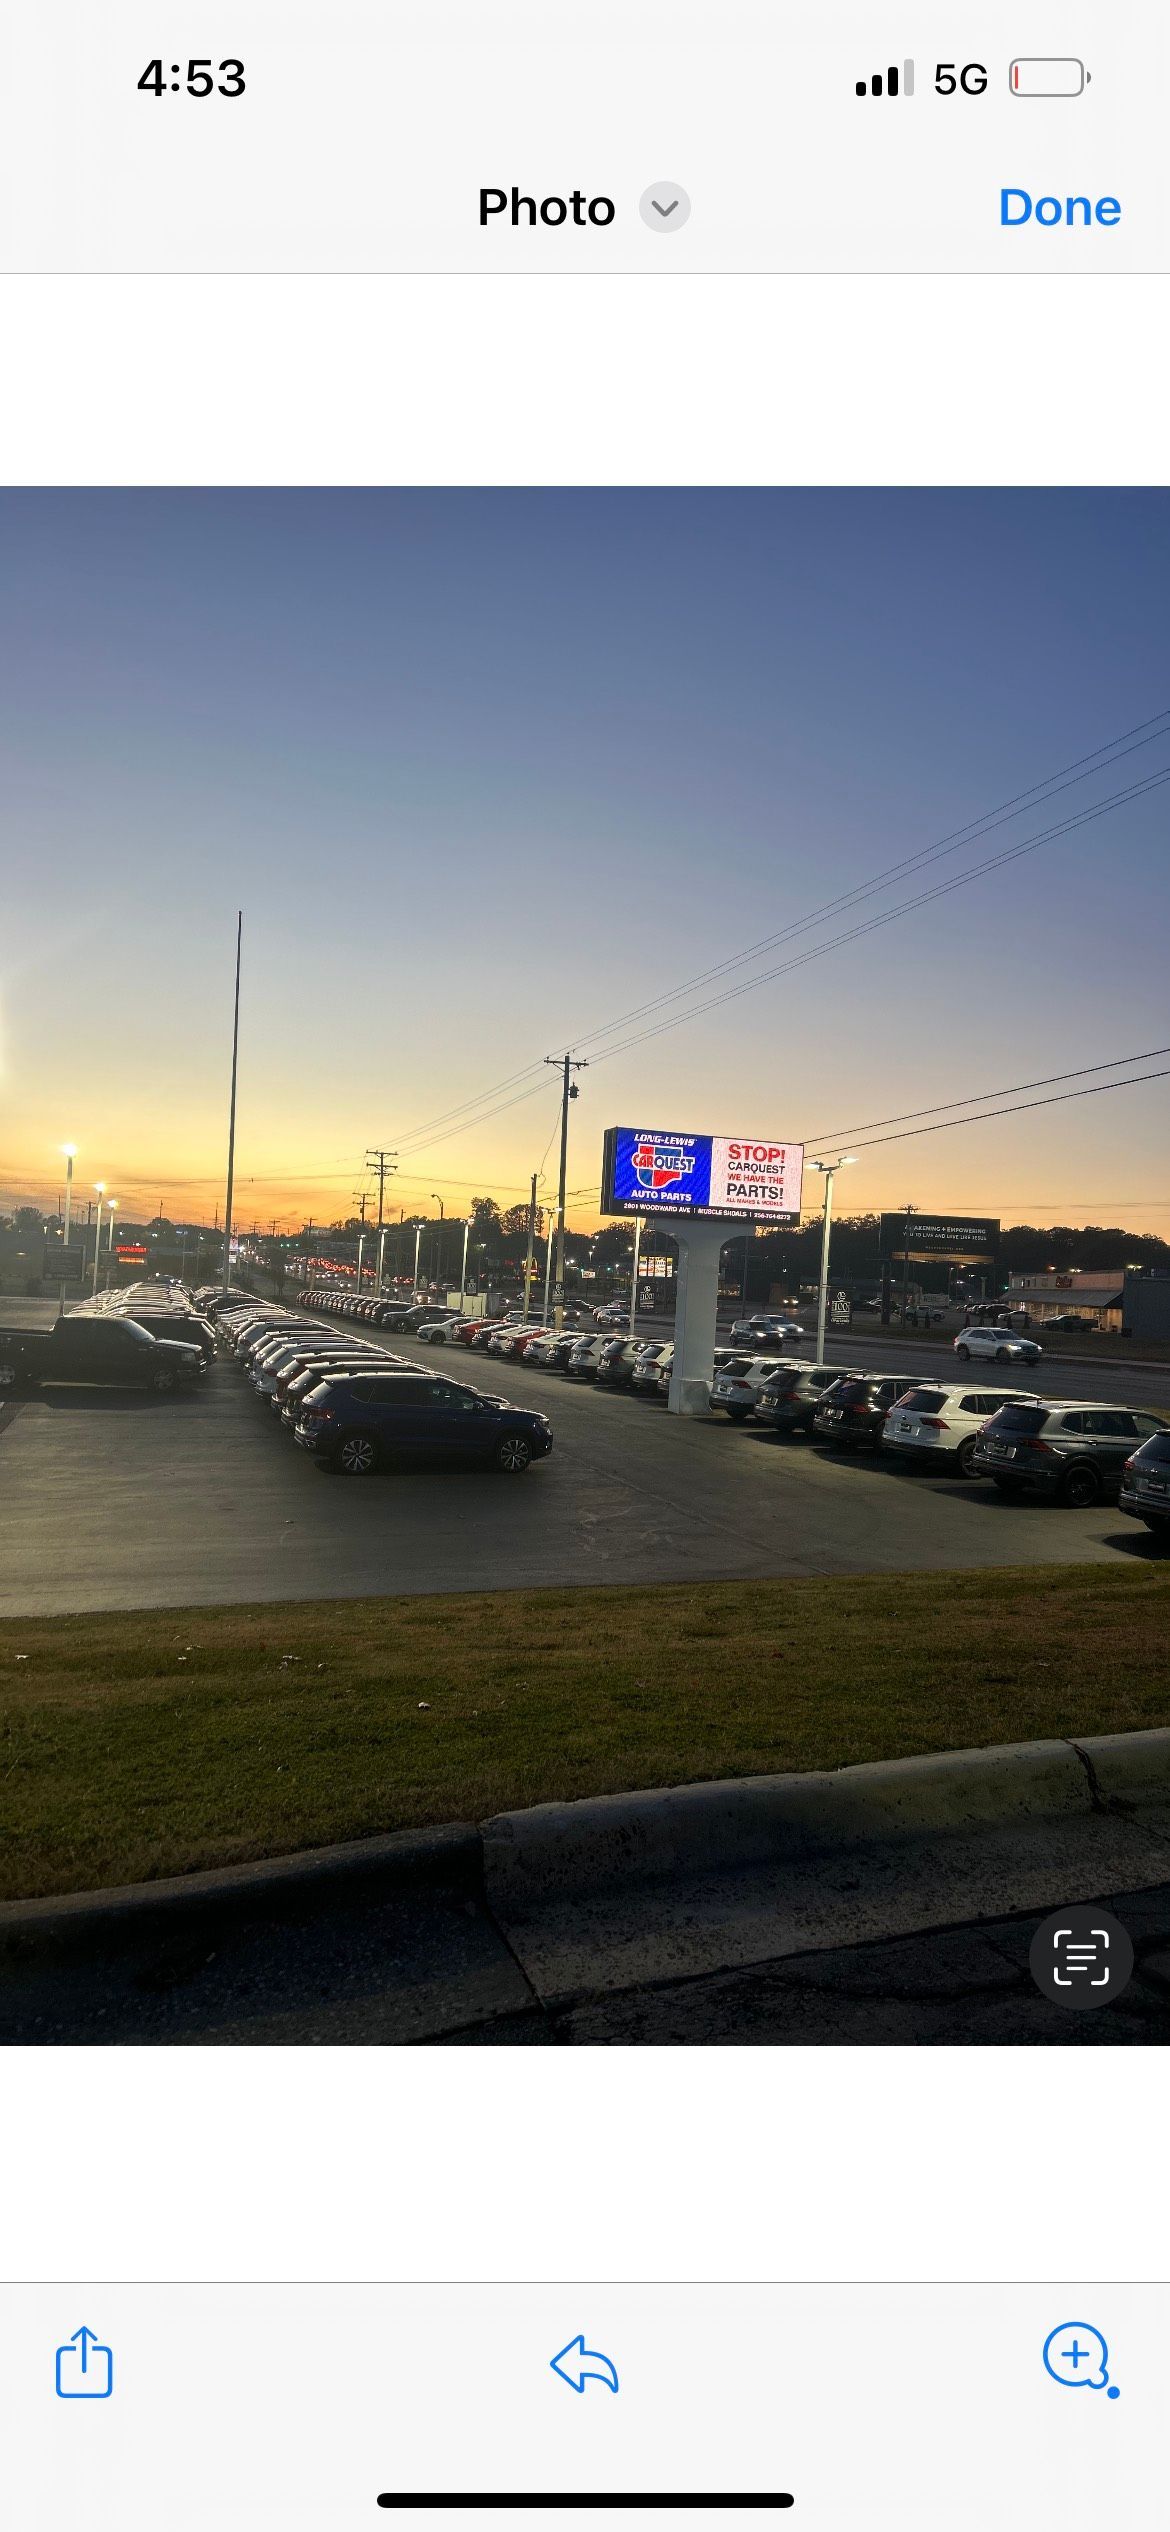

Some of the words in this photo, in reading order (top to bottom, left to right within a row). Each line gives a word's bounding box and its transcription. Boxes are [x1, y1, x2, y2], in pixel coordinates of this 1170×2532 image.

[634, 1134, 695, 1146] LONG-LEWIS
[728, 1144, 785, 1163] STOP!
[633, 1154, 694, 1171] CARQUEST
[728, 1162, 785, 1174] CARQUEST
[728, 1173, 741, 1181] WE
[744, 1174, 766, 1183] HAVE
[768, 1176, 784, 1185] THE
[631, 1190, 658, 1198] AUTO
[661, 1192, 692, 1201] PARTS
[727, 1183, 783, 1199] PARTS!
[639, 1203, 677, 1211] WOODWARD
[698, 1208, 722, 1216] MUSCLE
[946, 1226, 987, 1234] EMPOWERING
